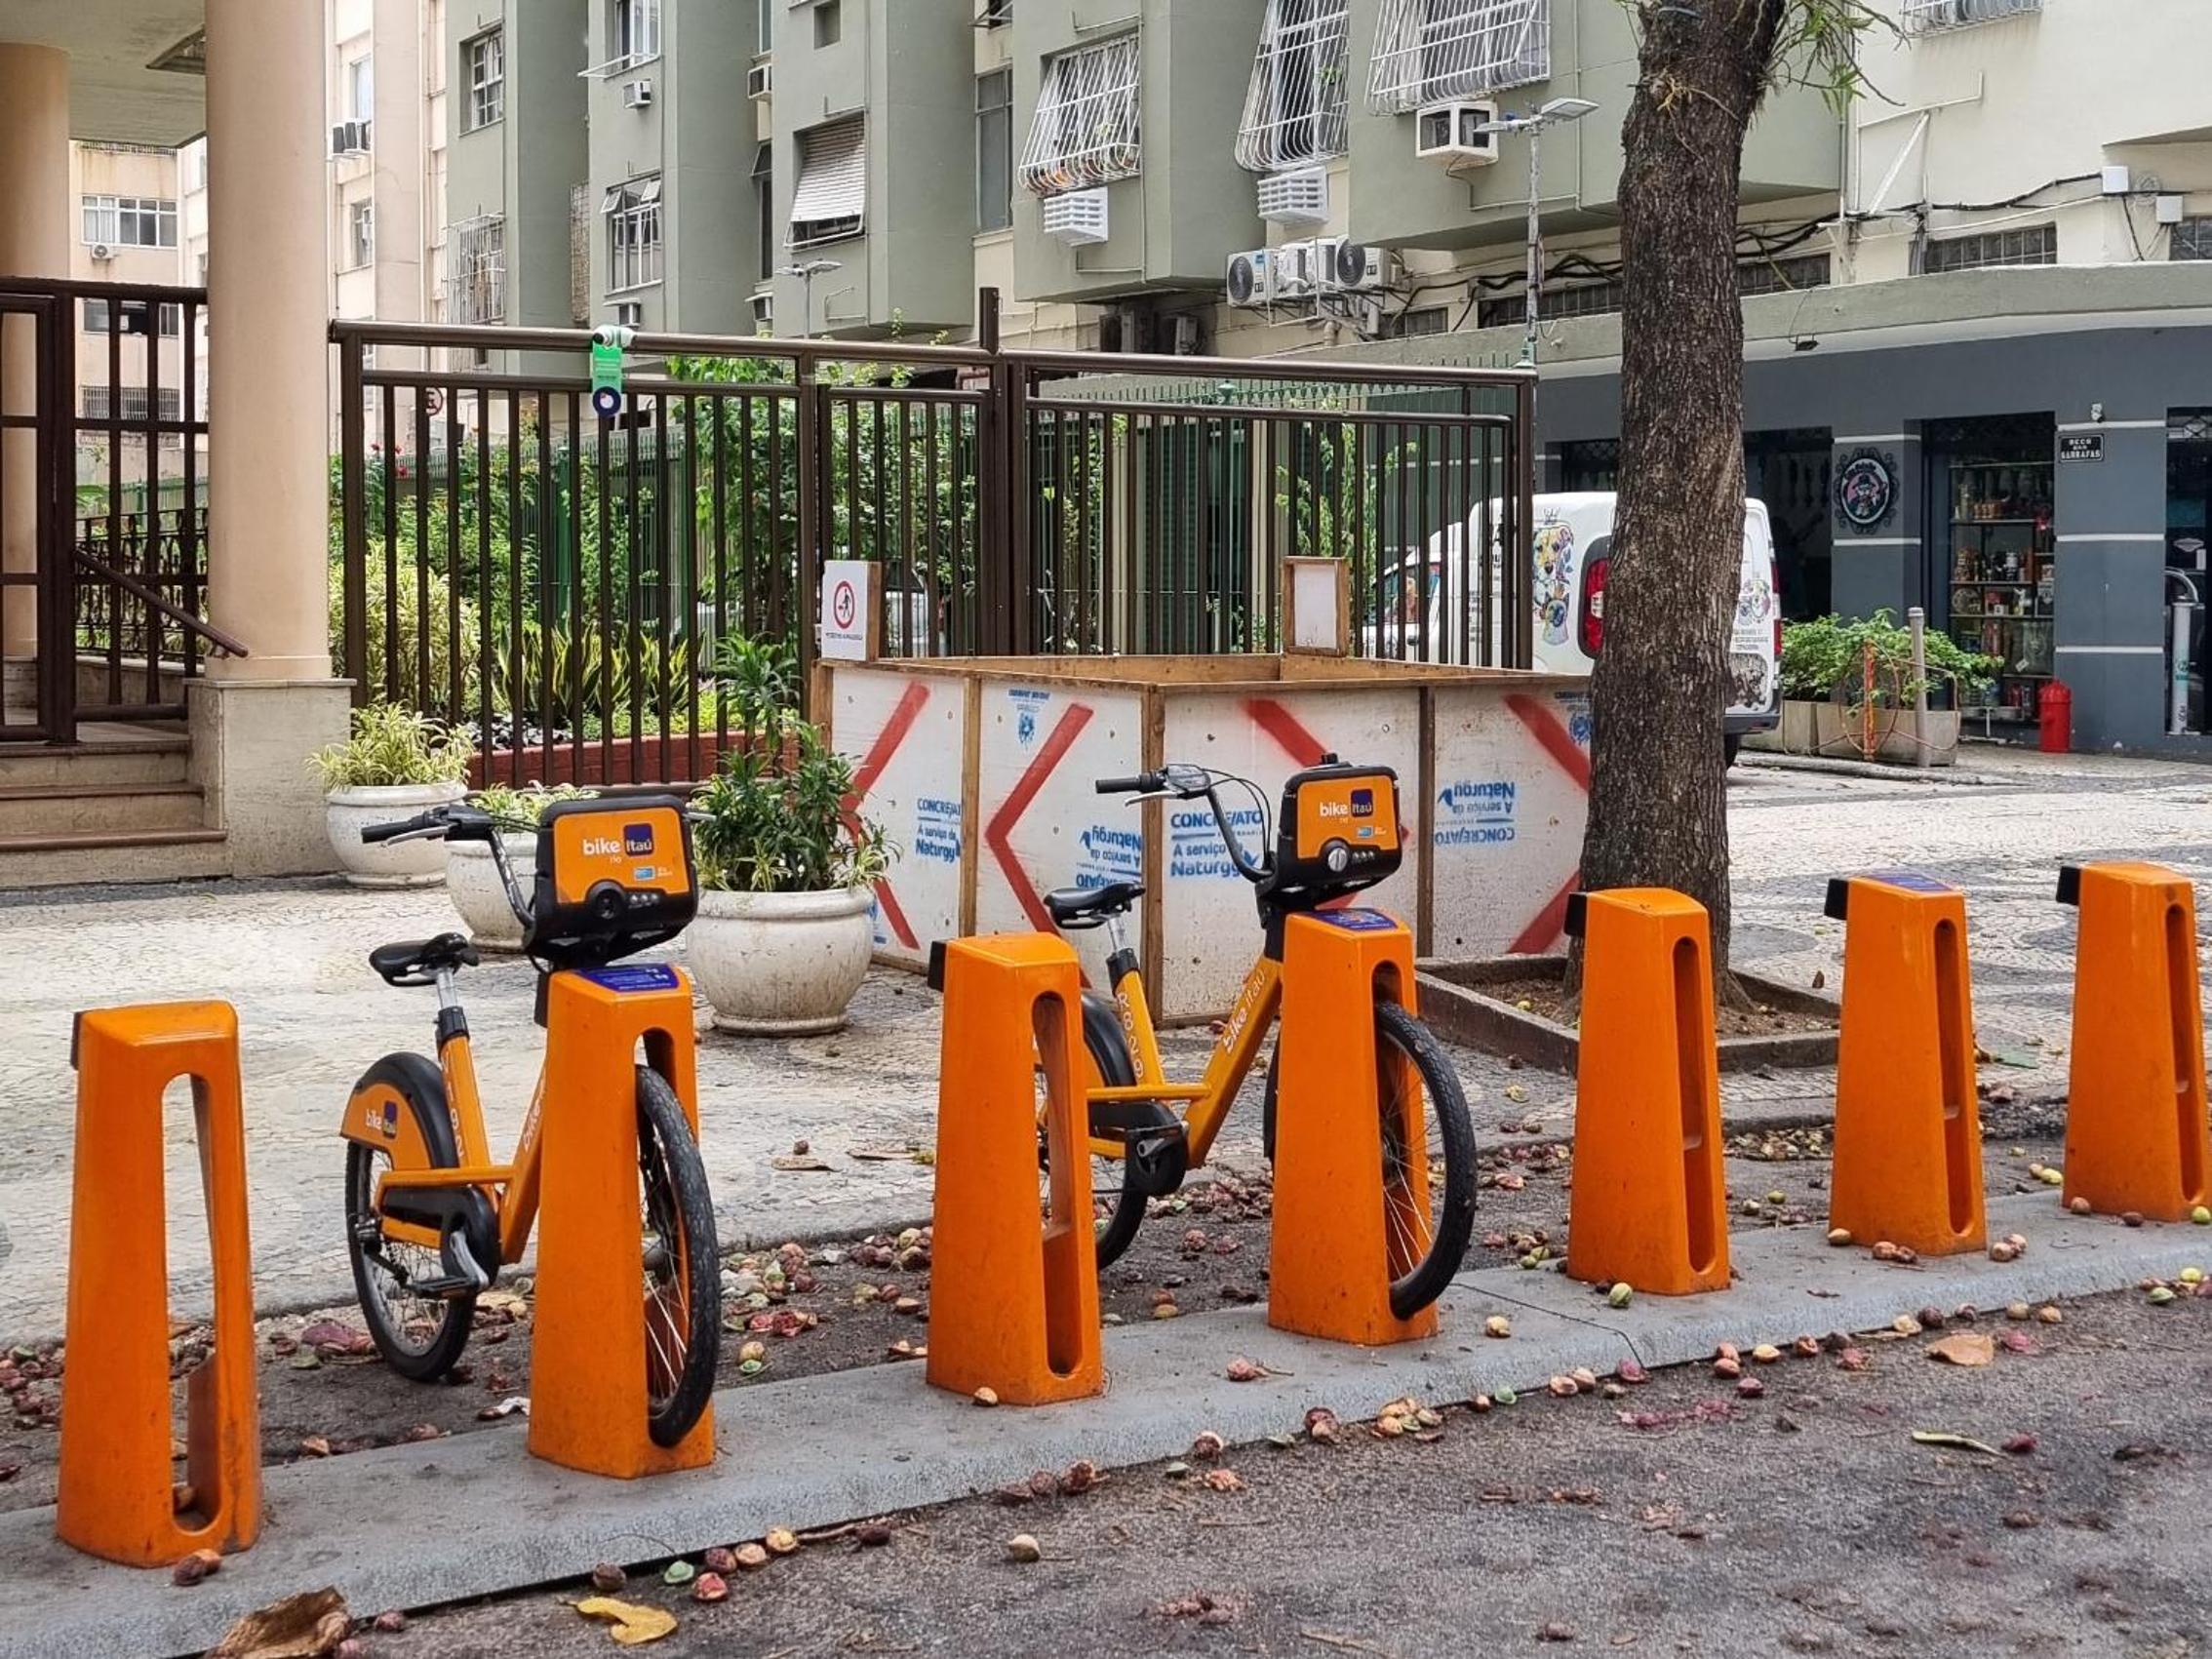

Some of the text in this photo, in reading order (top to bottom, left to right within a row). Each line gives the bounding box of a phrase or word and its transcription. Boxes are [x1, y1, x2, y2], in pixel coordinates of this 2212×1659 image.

[2061, 450, 2101, 459] GARRAFAS
[1319, 802, 1348, 817] bike
[1504, 802, 1513, 813] A
[1091, 825, 1143, 851] Naturgy
[583, 838, 652, 855] bike Itaú
[916, 838, 955, 863] Naturgy
[1173, 843, 1226, 857] A serviço
